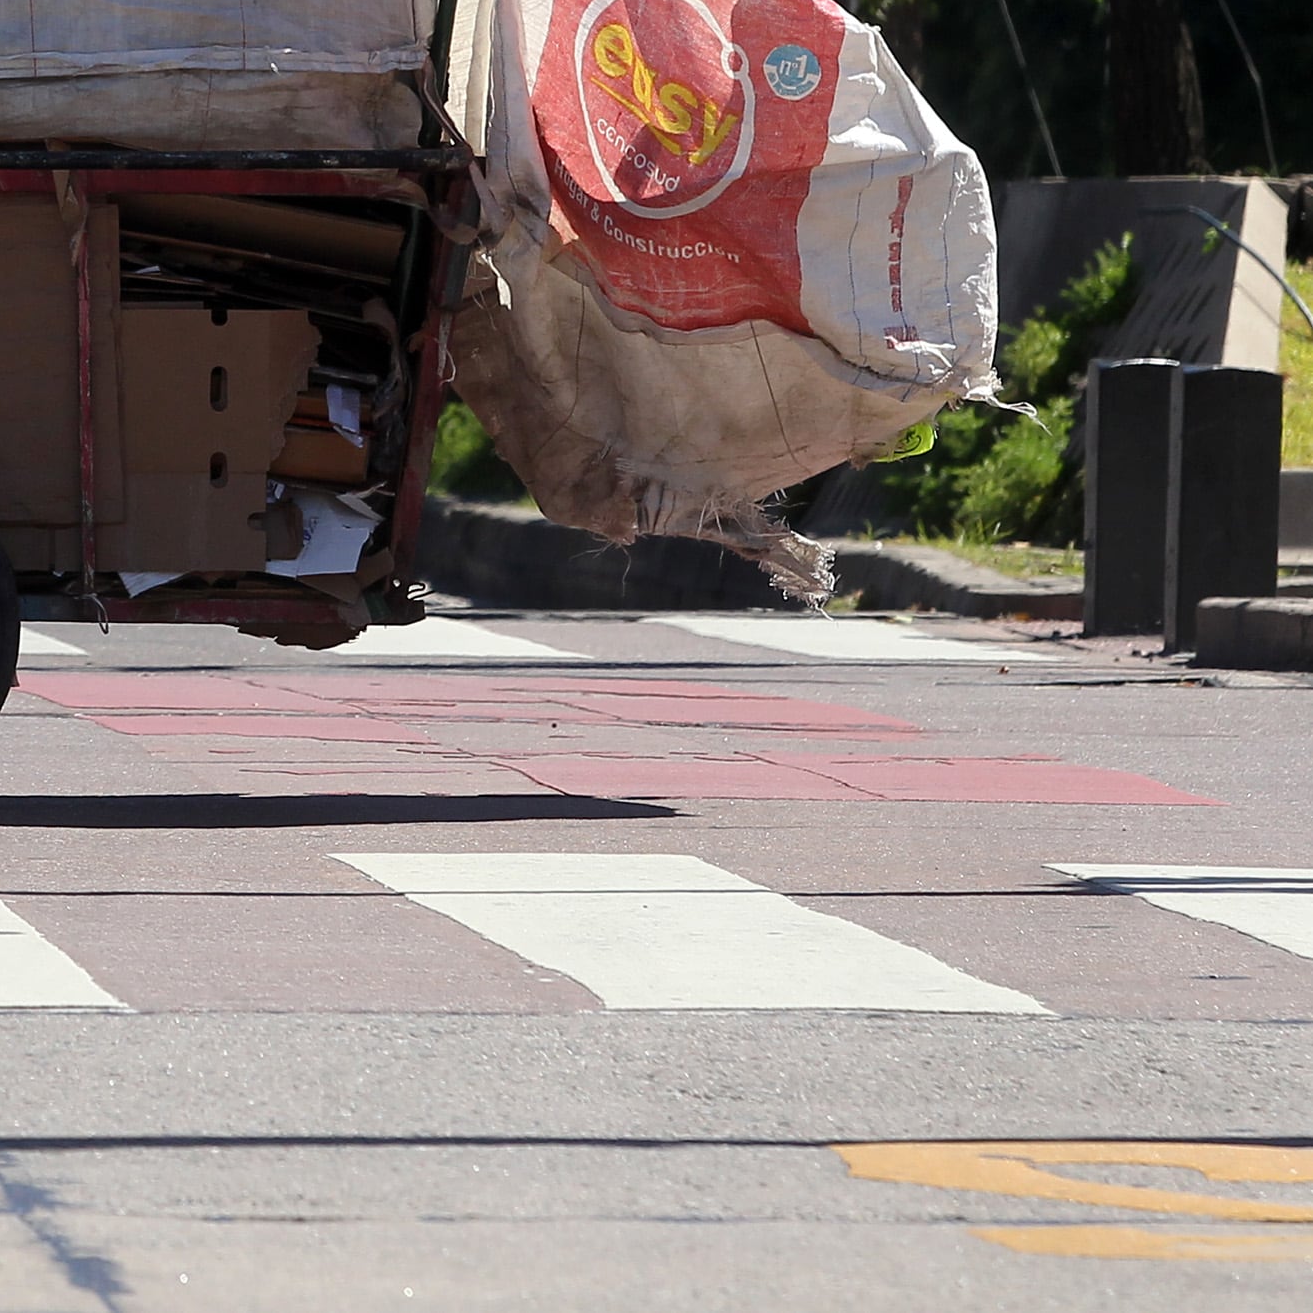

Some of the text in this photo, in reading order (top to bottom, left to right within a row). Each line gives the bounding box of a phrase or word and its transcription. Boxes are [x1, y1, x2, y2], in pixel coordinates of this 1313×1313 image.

[593, 23, 740, 165] easy
[596, 118, 681, 192] cencosud
[590, 201, 601, 224] &
